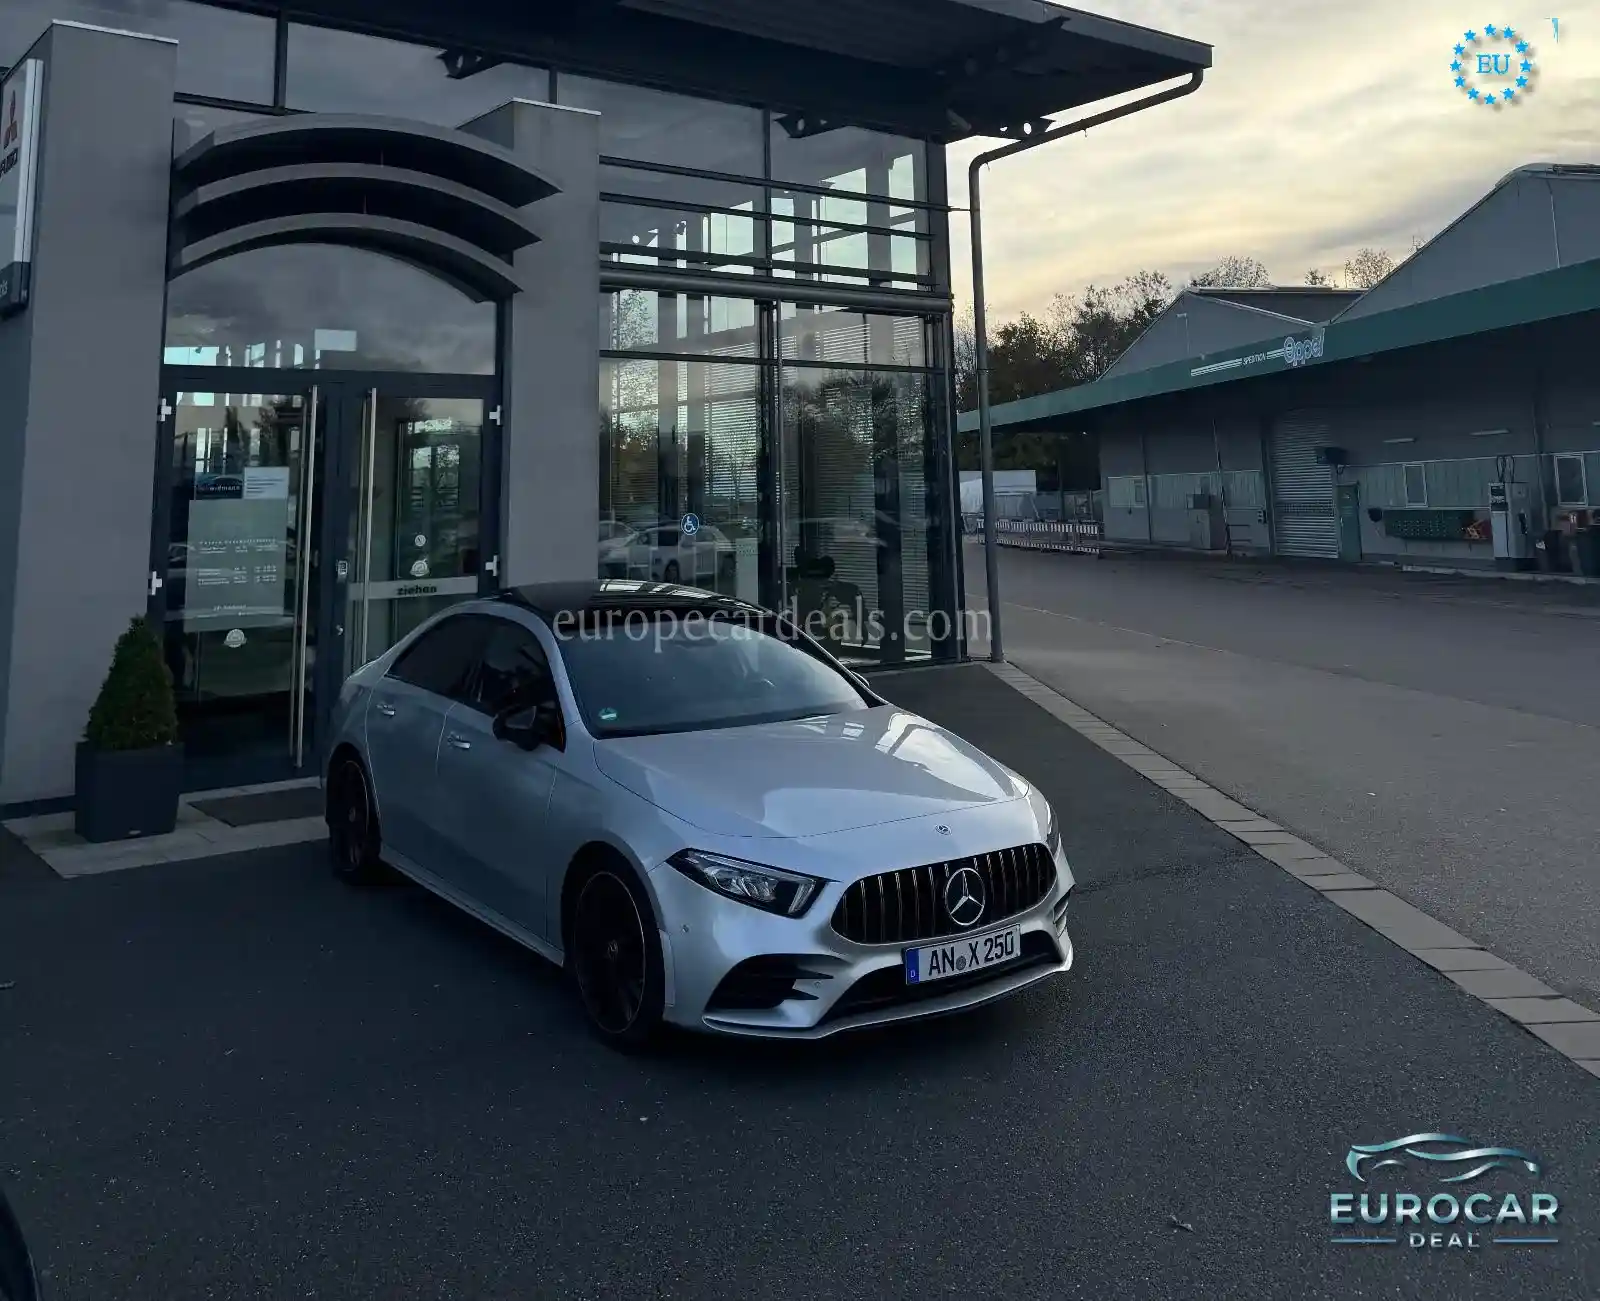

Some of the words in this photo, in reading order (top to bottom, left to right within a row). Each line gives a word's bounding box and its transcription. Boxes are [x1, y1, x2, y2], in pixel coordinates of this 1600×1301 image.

[929, 946, 955, 976] AN
[968, 941, 980, 967] X
[984, 931, 1014, 962] 250
